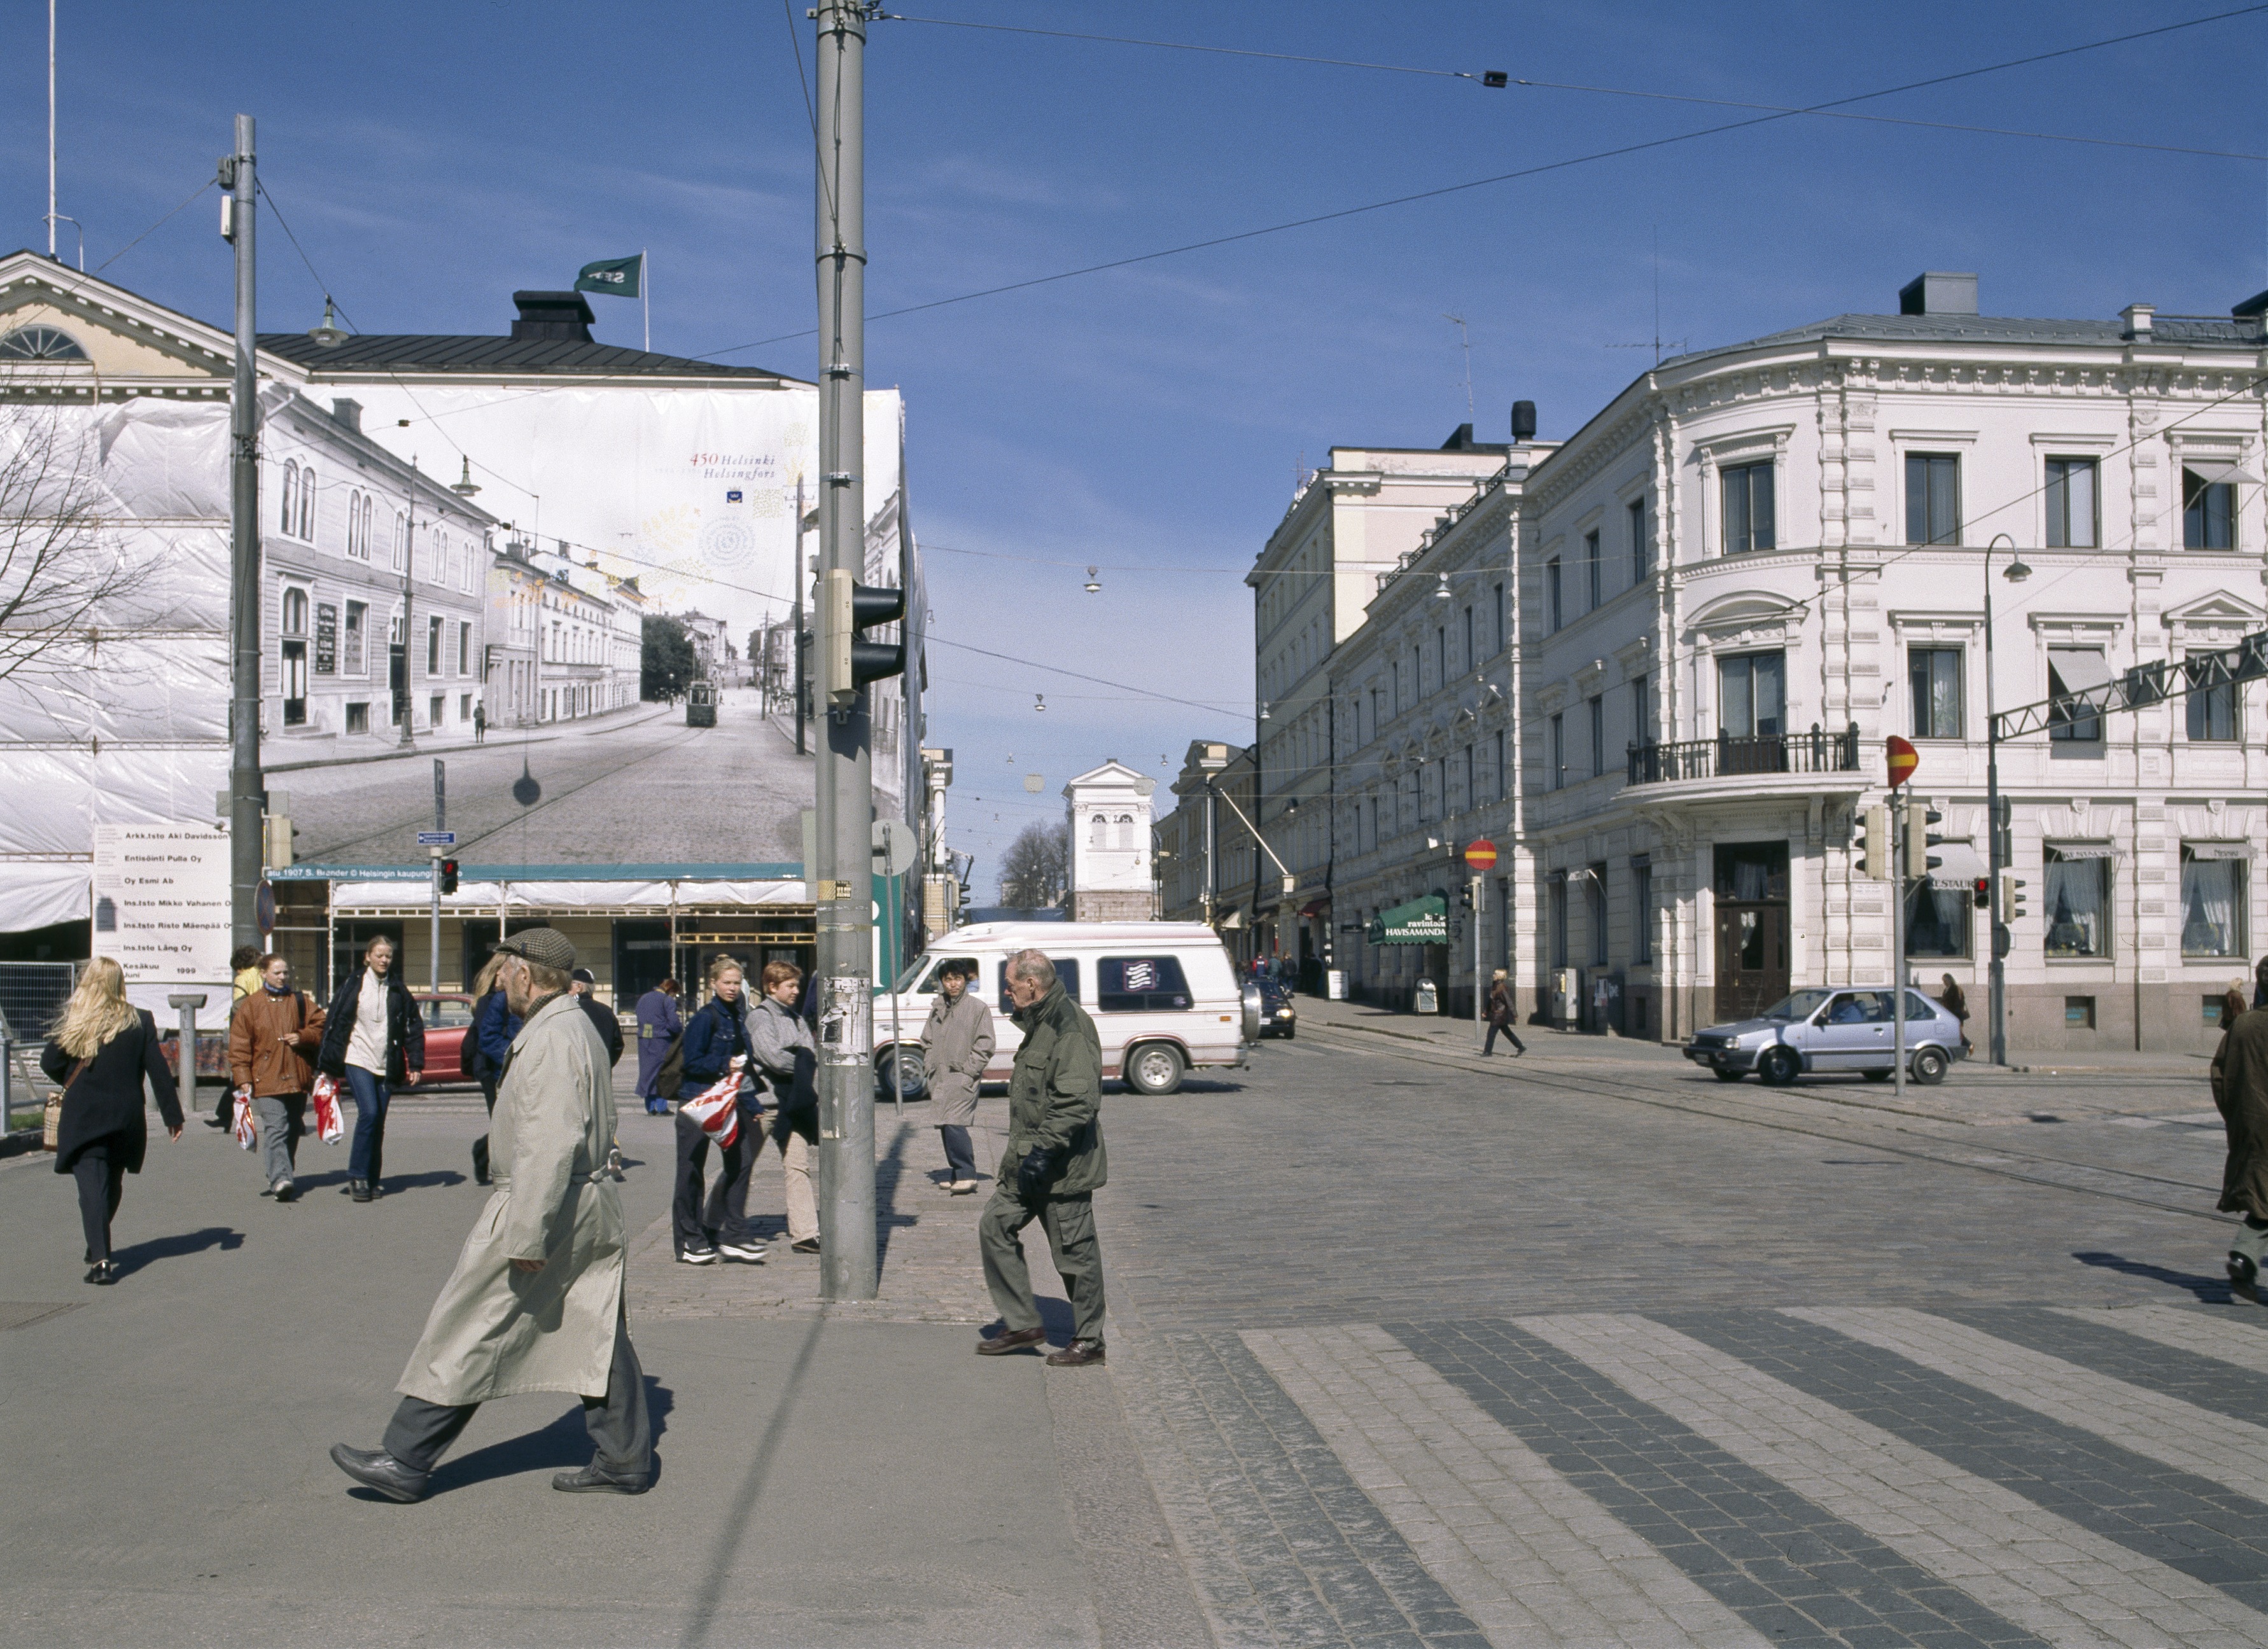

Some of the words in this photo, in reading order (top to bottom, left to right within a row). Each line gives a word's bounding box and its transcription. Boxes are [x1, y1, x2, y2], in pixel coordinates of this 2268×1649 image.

[690, 453, 718, 467] 450
[721, 454, 774, 465] Helsinki
[704, 468, 774, 481] Helsingfors
[190, 855, 202, 863] Oy
[284, 868, 303, 877] 1907
[360, 870, 395, 879] Helsingin
[397, 870, 433, 879] kaupungi
